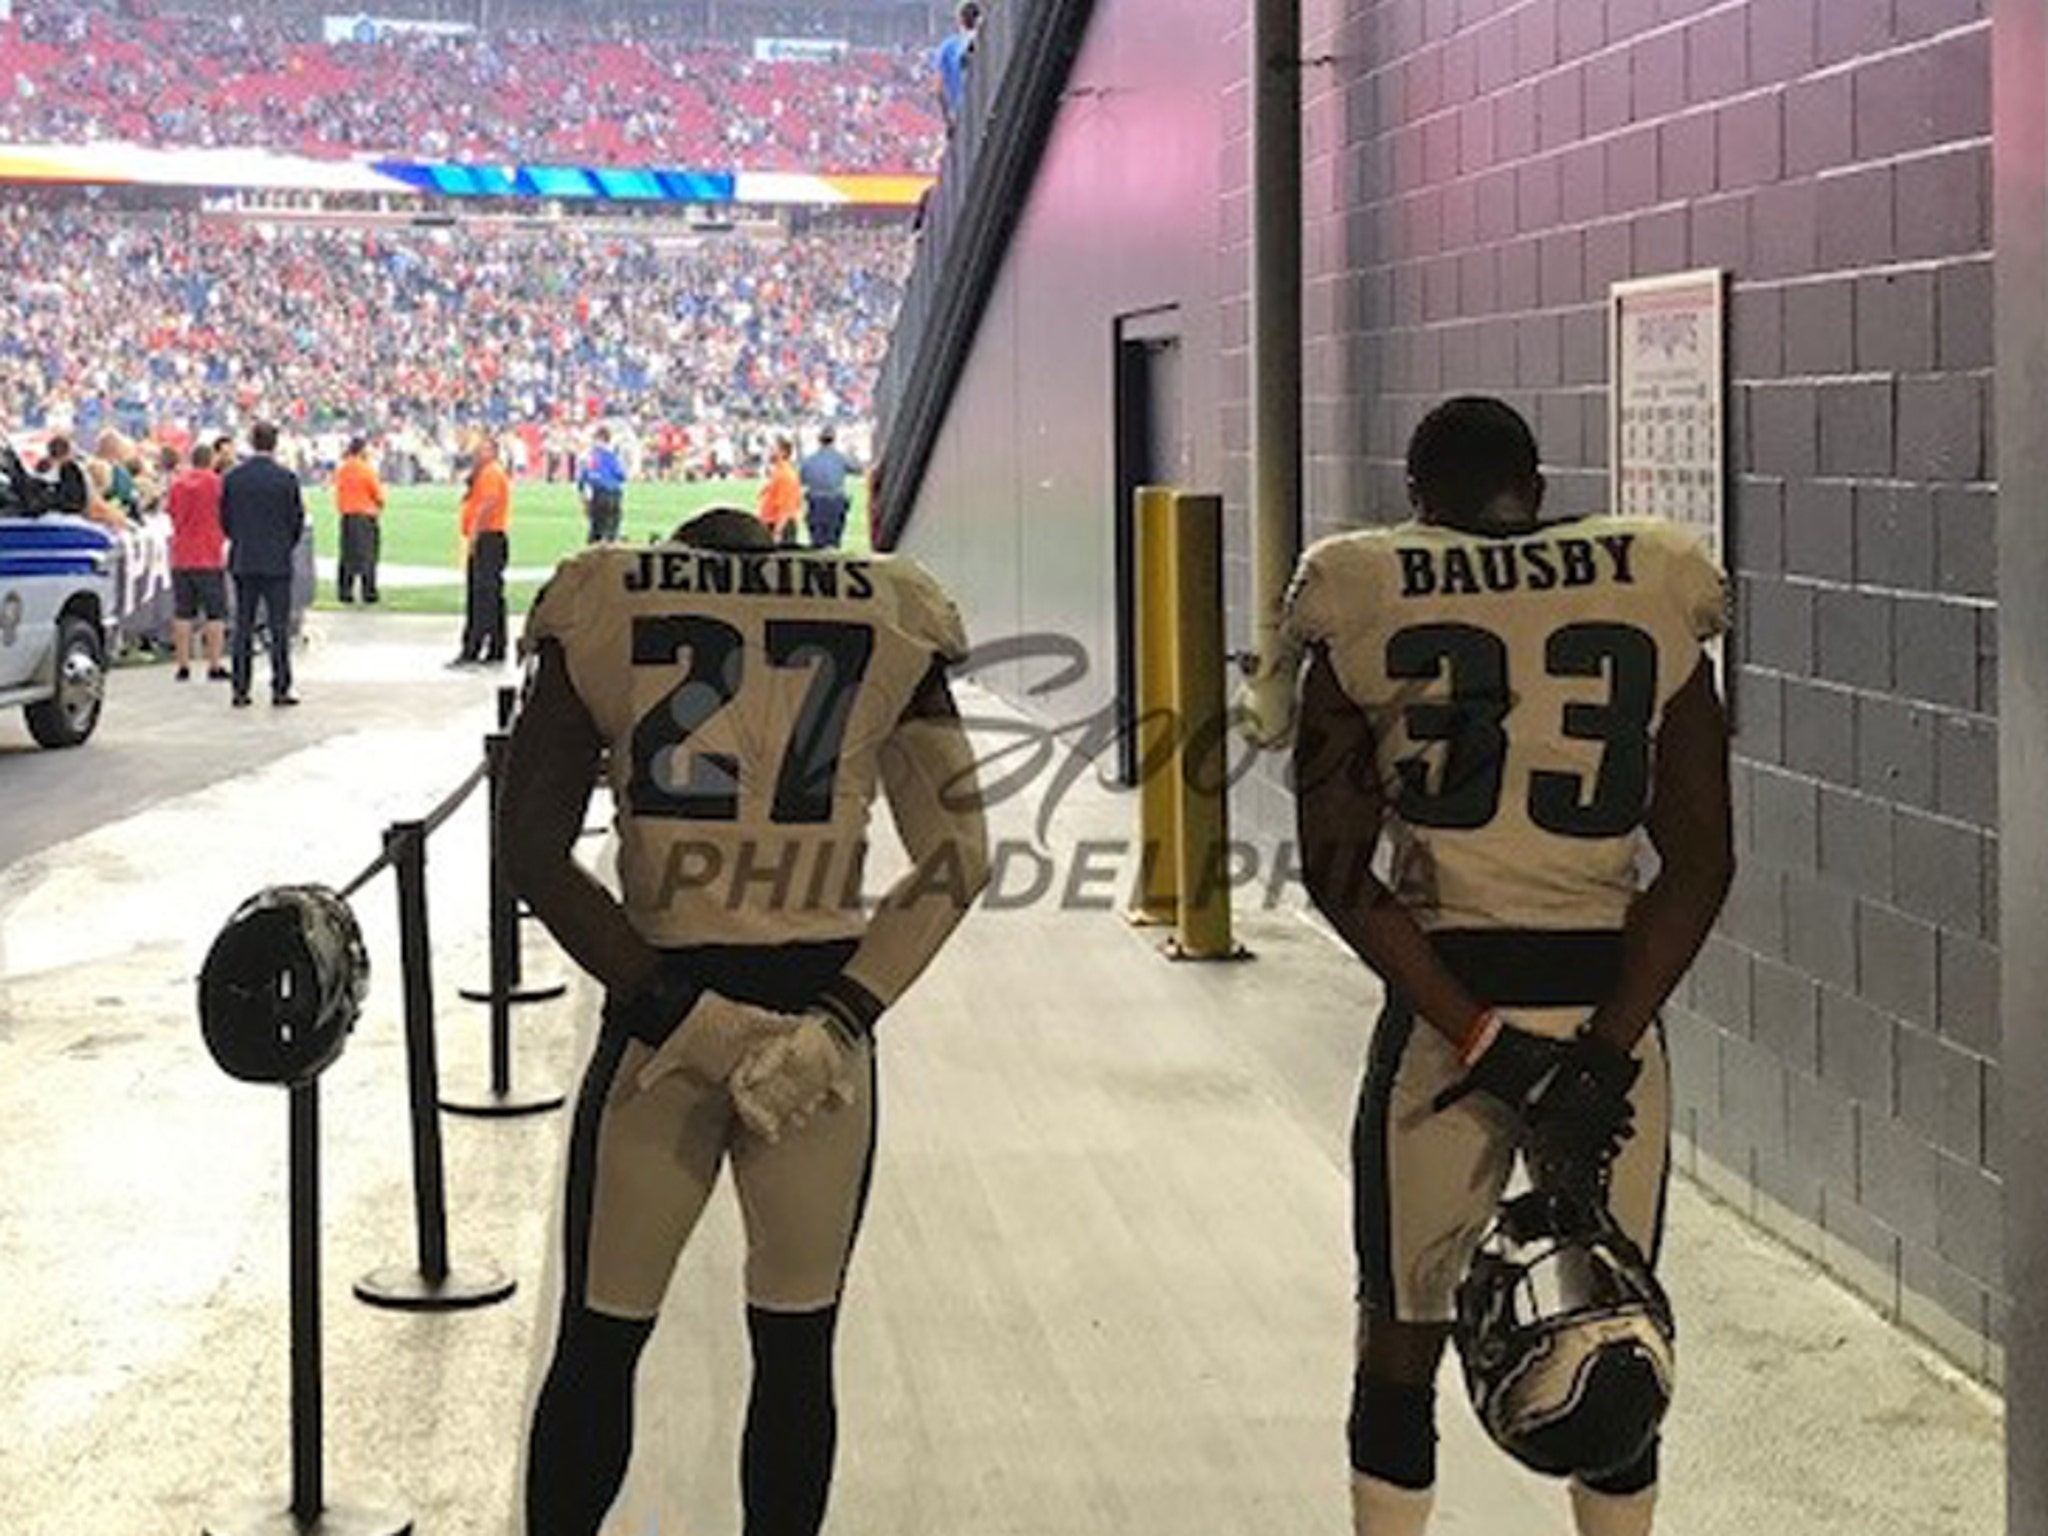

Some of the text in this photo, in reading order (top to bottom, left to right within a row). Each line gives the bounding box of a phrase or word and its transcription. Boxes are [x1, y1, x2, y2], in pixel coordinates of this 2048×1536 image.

[625, 553, 873, 599] JENKINS
[1398, 536, 1634, 597] BAUSBY
[631, 616, 873, 822] 27
[1385, 623, 1659, 837] 33
